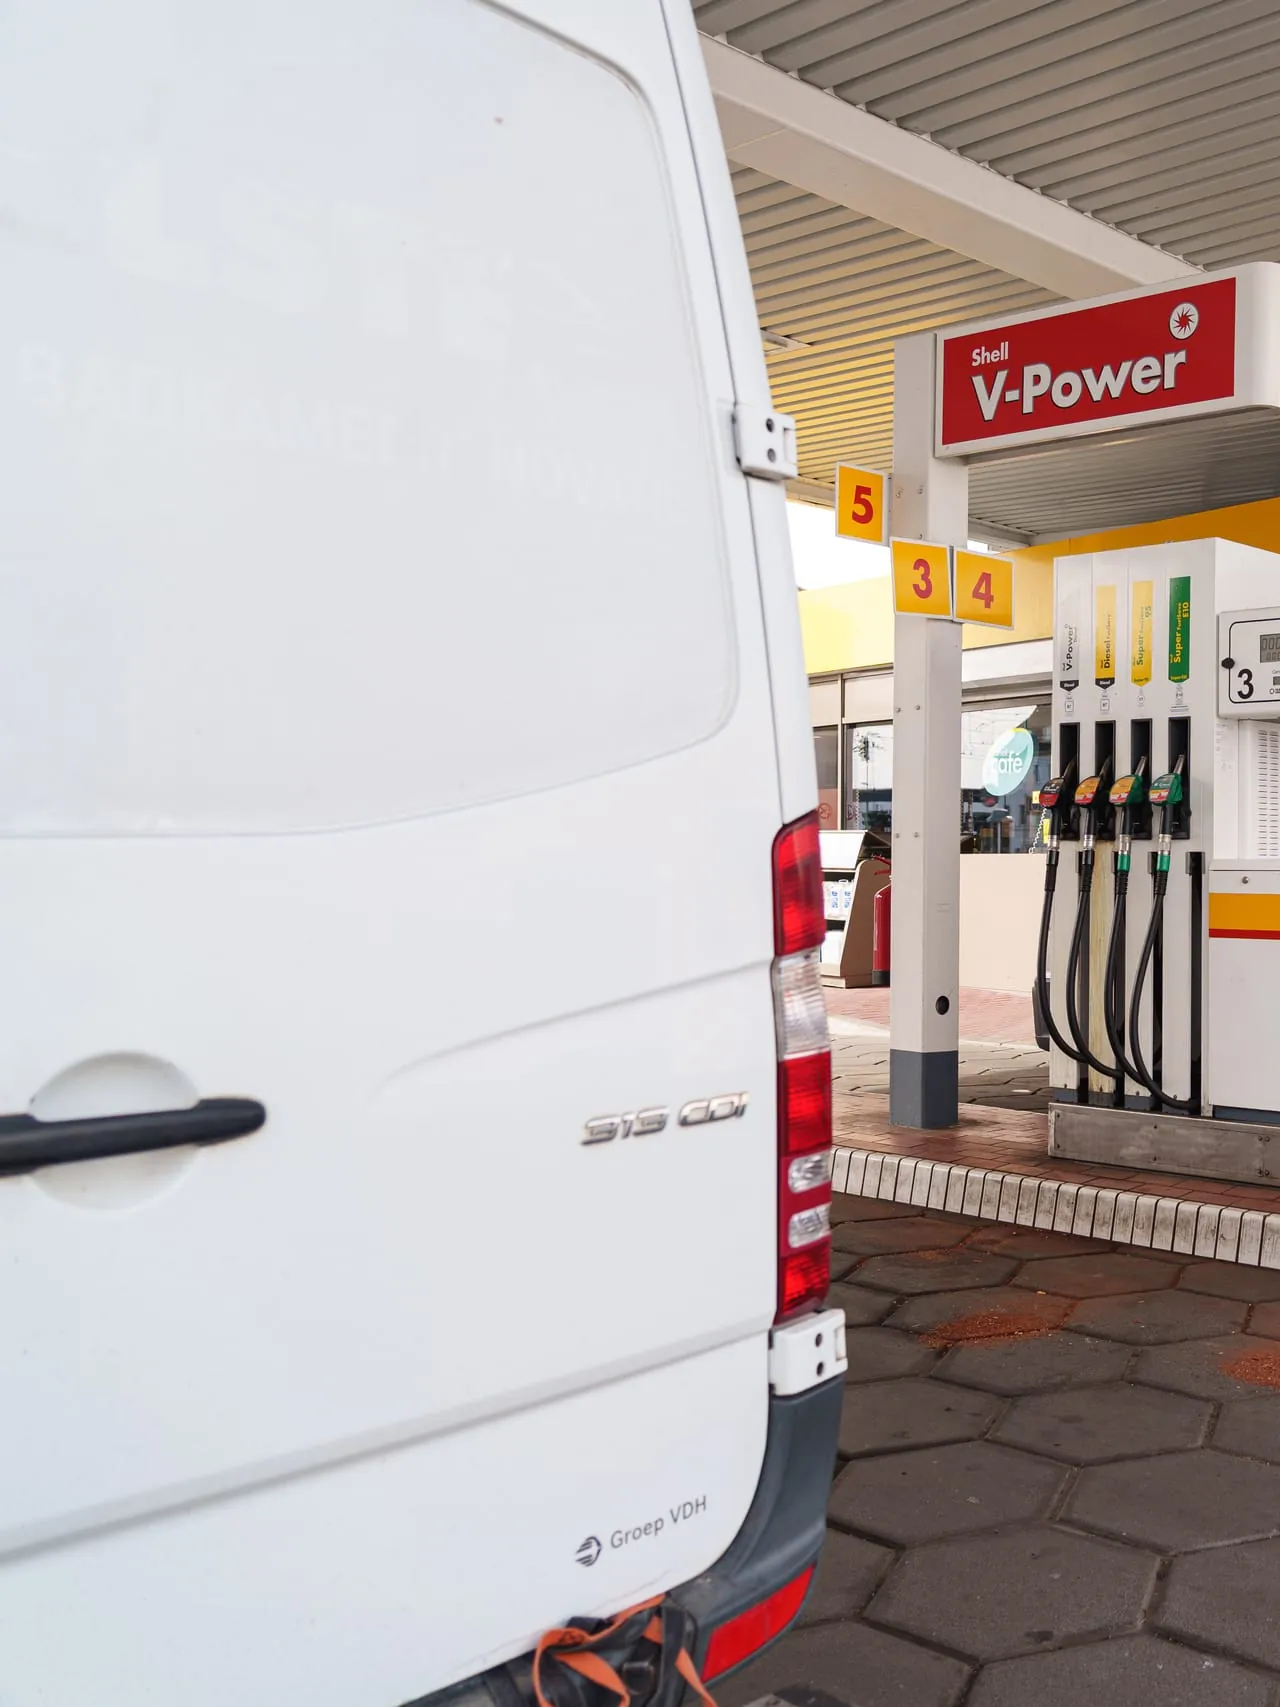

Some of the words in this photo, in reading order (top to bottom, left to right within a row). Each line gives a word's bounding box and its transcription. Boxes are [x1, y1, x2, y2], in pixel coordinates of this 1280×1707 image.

[971, 341, 1009, 367] Shell
[971, 349, 1187, 421] V-Power
[851, 485, 874, 524] 5
[912, 558, 933, 599] 3
[972, 571, 994, 609] 4
[1182, 602, 1190, 618] E10
[1103, 640, 1111, 669] Diesel
[1137, 635, 1145, 666] Super
[1173, 631, 1183, 663] Super
[1237, 668, 1254, 699] 3
[678, 1091, 750, 1127] CDI
[610, 1517, 665, 1549] Groep
[669, 1495, 707, 1525] VDH
